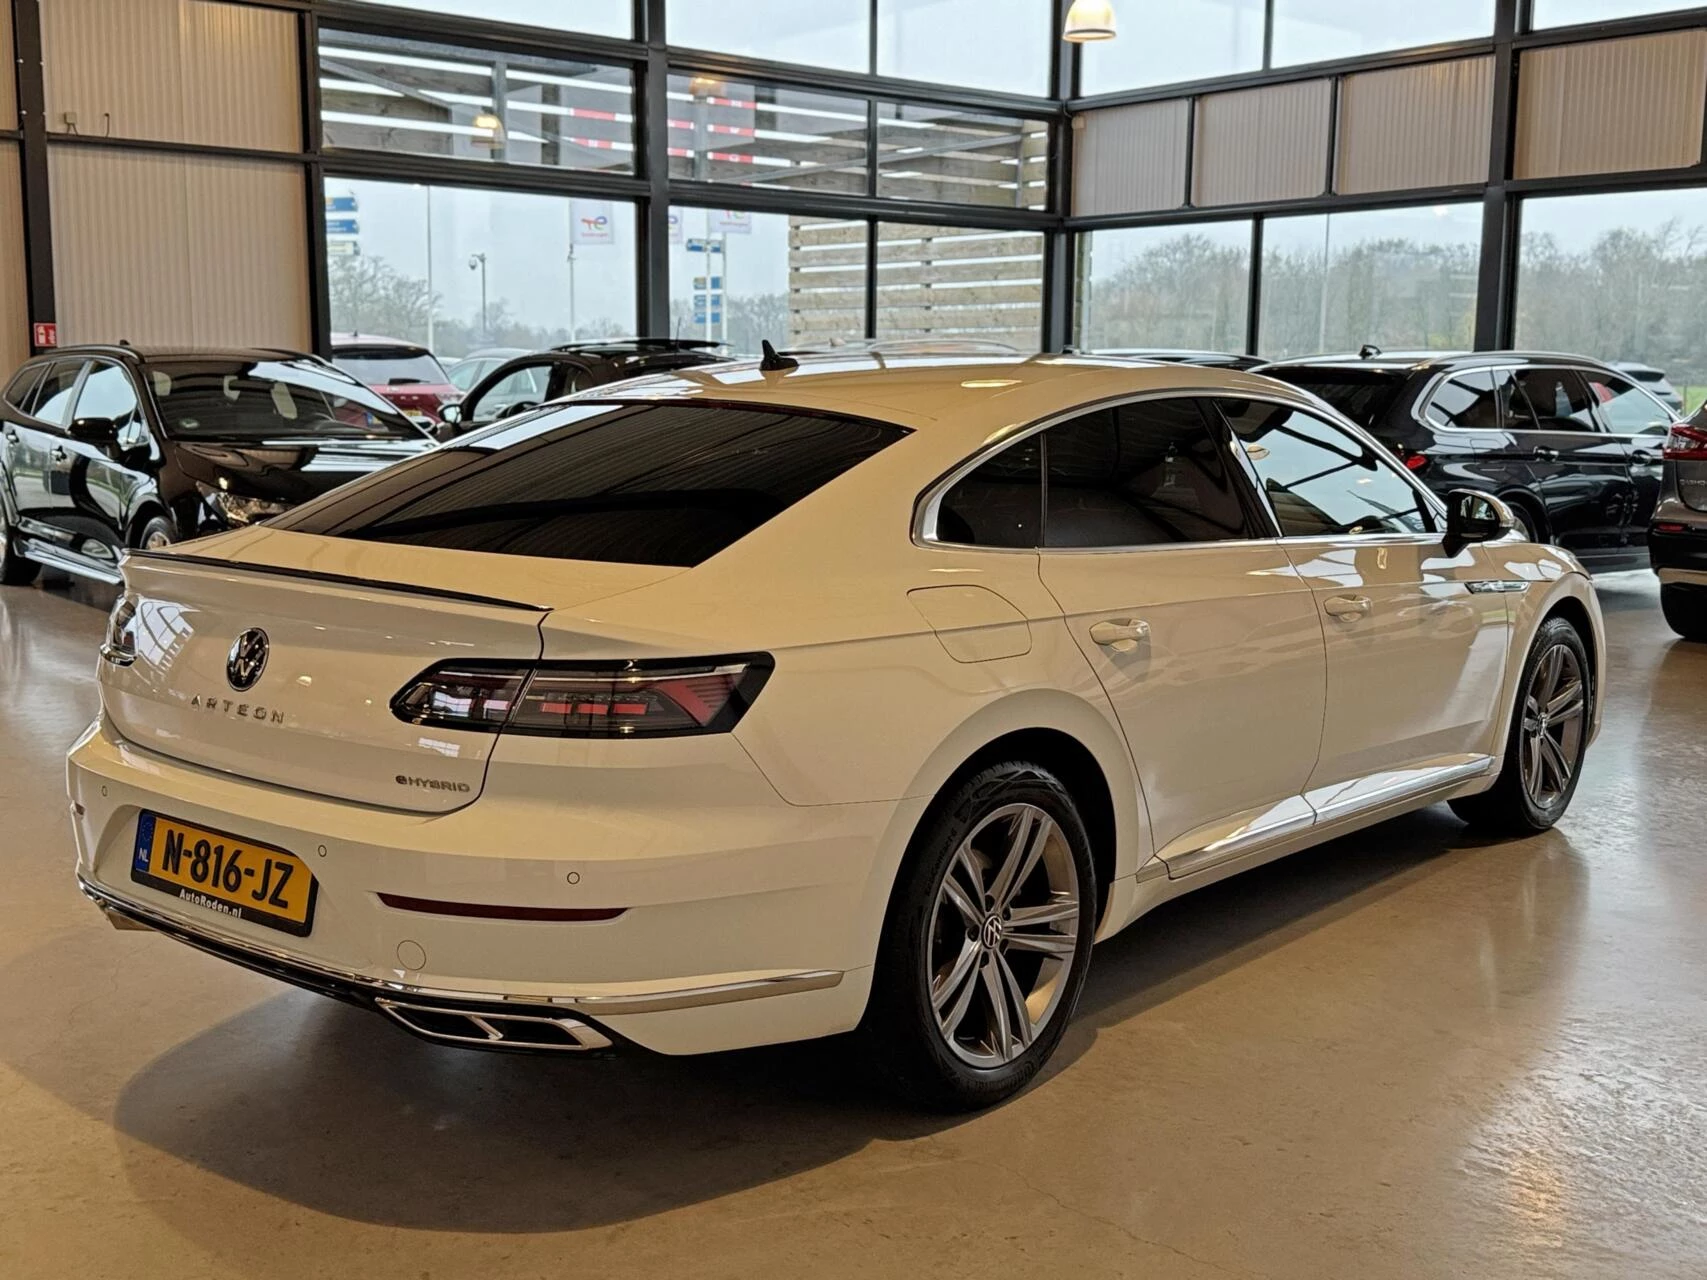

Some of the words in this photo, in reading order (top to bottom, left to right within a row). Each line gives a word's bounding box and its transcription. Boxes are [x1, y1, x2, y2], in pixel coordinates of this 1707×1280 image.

[191, 693, 285, 724] ARTEON
[138, 849, 149, 862] NL
[161, 828, 294, 910] N-816-JZ
[179, 888, 242, 919] AutoRoden.nl
